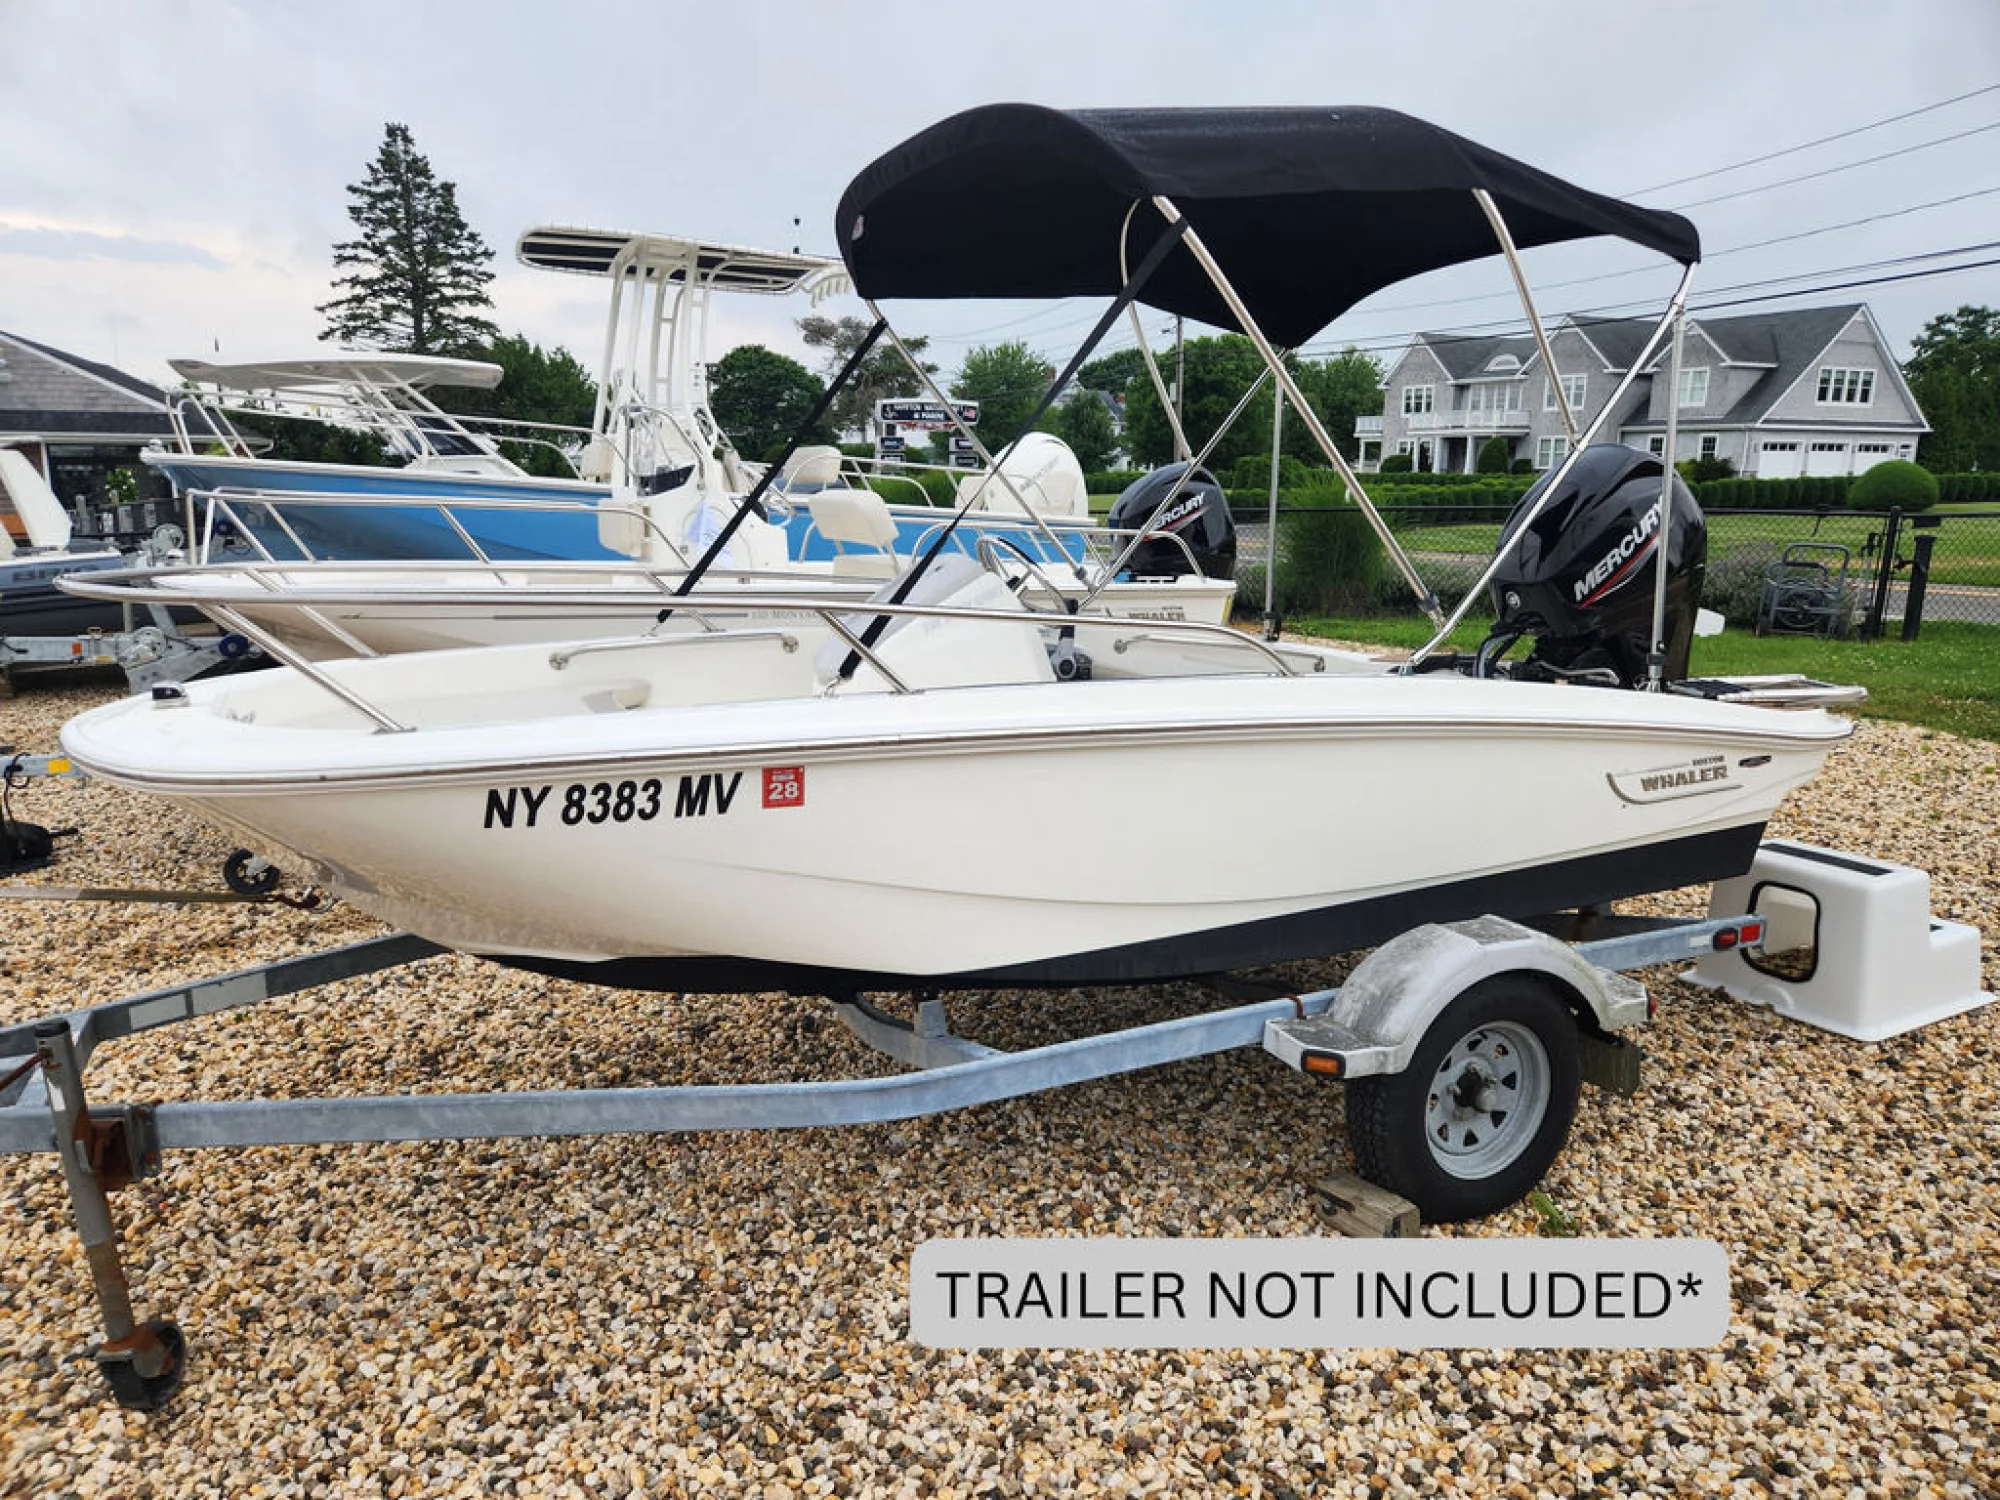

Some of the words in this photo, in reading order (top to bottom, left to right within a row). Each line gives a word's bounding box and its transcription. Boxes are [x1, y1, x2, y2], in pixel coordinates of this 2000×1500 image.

[769, 781, 799, 800] 28
[1641, 765, 1729, 792] WHALER
[484, 785, 552, 828] NY
[561, 778, 663, 825] 8383
[674, 771, 743, 818] MV
